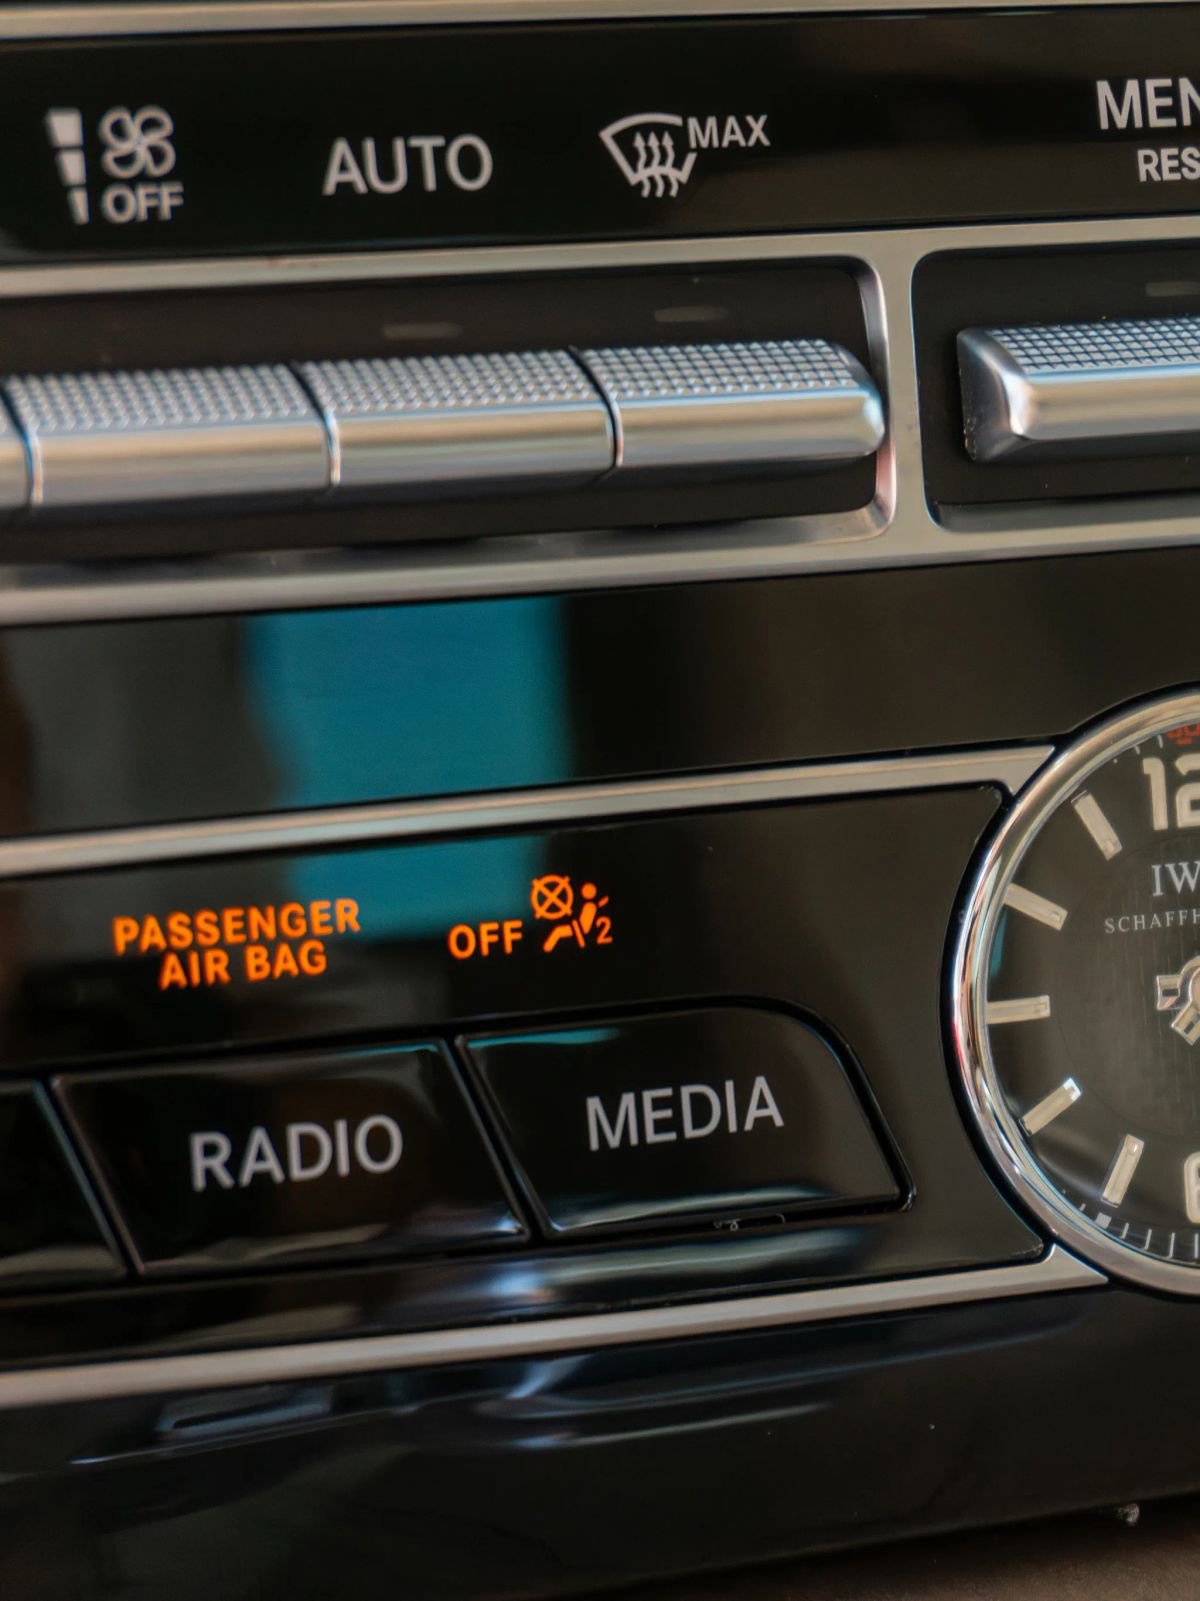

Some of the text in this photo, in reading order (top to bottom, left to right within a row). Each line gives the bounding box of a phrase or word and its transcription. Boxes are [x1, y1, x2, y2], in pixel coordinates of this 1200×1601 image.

[686, 114, 771, 149] MAX
[323, 133, 494, 196] AUTO
[102, 183, 184, 224] OFF
[113, 898, 360, 956] PASSENGER
[447, 919, 523, 960] OFF
[159, 939, 328, 990] AIR BAG
[586, 1075, 785, 1152] MEDIA
[190, 1115, 404, 1191] RADIO
